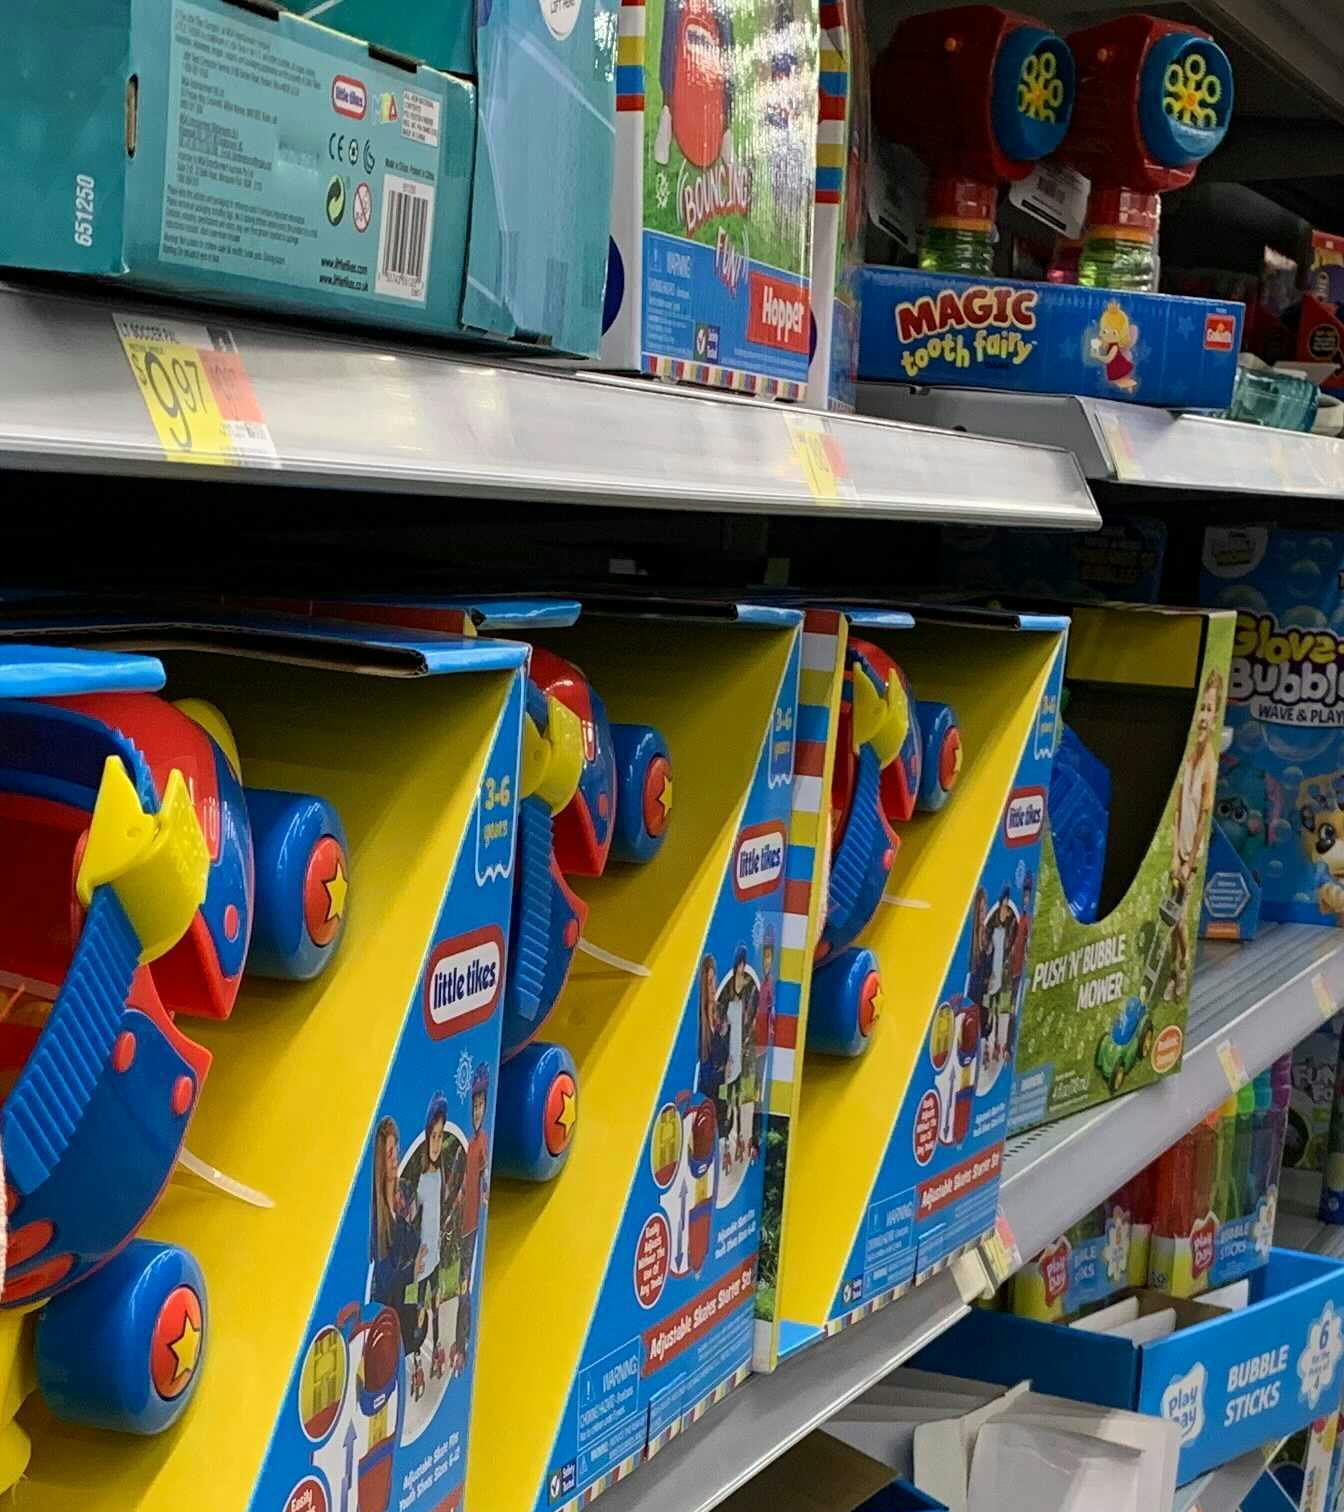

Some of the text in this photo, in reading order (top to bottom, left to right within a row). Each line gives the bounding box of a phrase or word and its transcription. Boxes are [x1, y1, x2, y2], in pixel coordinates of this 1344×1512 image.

[75, 174, 95, 247] 651250
[684, 163, 752, 230] BOUNCING
[762, 285, 805, 343] Hopper
[897, 286, 1038, 342] MAGIC
[901, 330, 1033, 377] tooth fairy
[1258, 704, 1292, 720] WAVE
[1296, 708, 1306, 721] &
[485, 775, 511, 811] 3-6
[1008, 804, 1041, 828] little tikes
[739, 843, 781, 878] little tikes
[1032, 960, 1067, 992] PUSH
[1083, 934, 1126, 974] BUBBLE
[432, 959, 497, 1010] little tikes
[1076, 971, 1123, 1012] MOWER
[921, 1179, 952, 1211] Adjustable
[1194, 1228, 1213, 1250] Play
[1219, 1241, 1246, 1260] STICKS
[1220, 1223, 1250, 1243] BUBBLE
[1047, 1259, 1066, 1278] Play
[1195, 1243, 1213, 1264] Day
[1048, 1274, 1067, 1295] Day
[650, 1314, 692, 1361] Adjustable
[693, 1298, 717, 1328] Skates
[718, 1280, 741, 1309] Starter
[742, 1268, 752, 1290] Set
[1318, 1320, 1331, 1349] 6
[1227, 1345, 1289, 1388] BUBBLE
[1167, 1385, 1197, 1412] Play
[1224, 1382, 1280, 1427] STICKS
[403, 1455, 432, 1490] Adjustable
